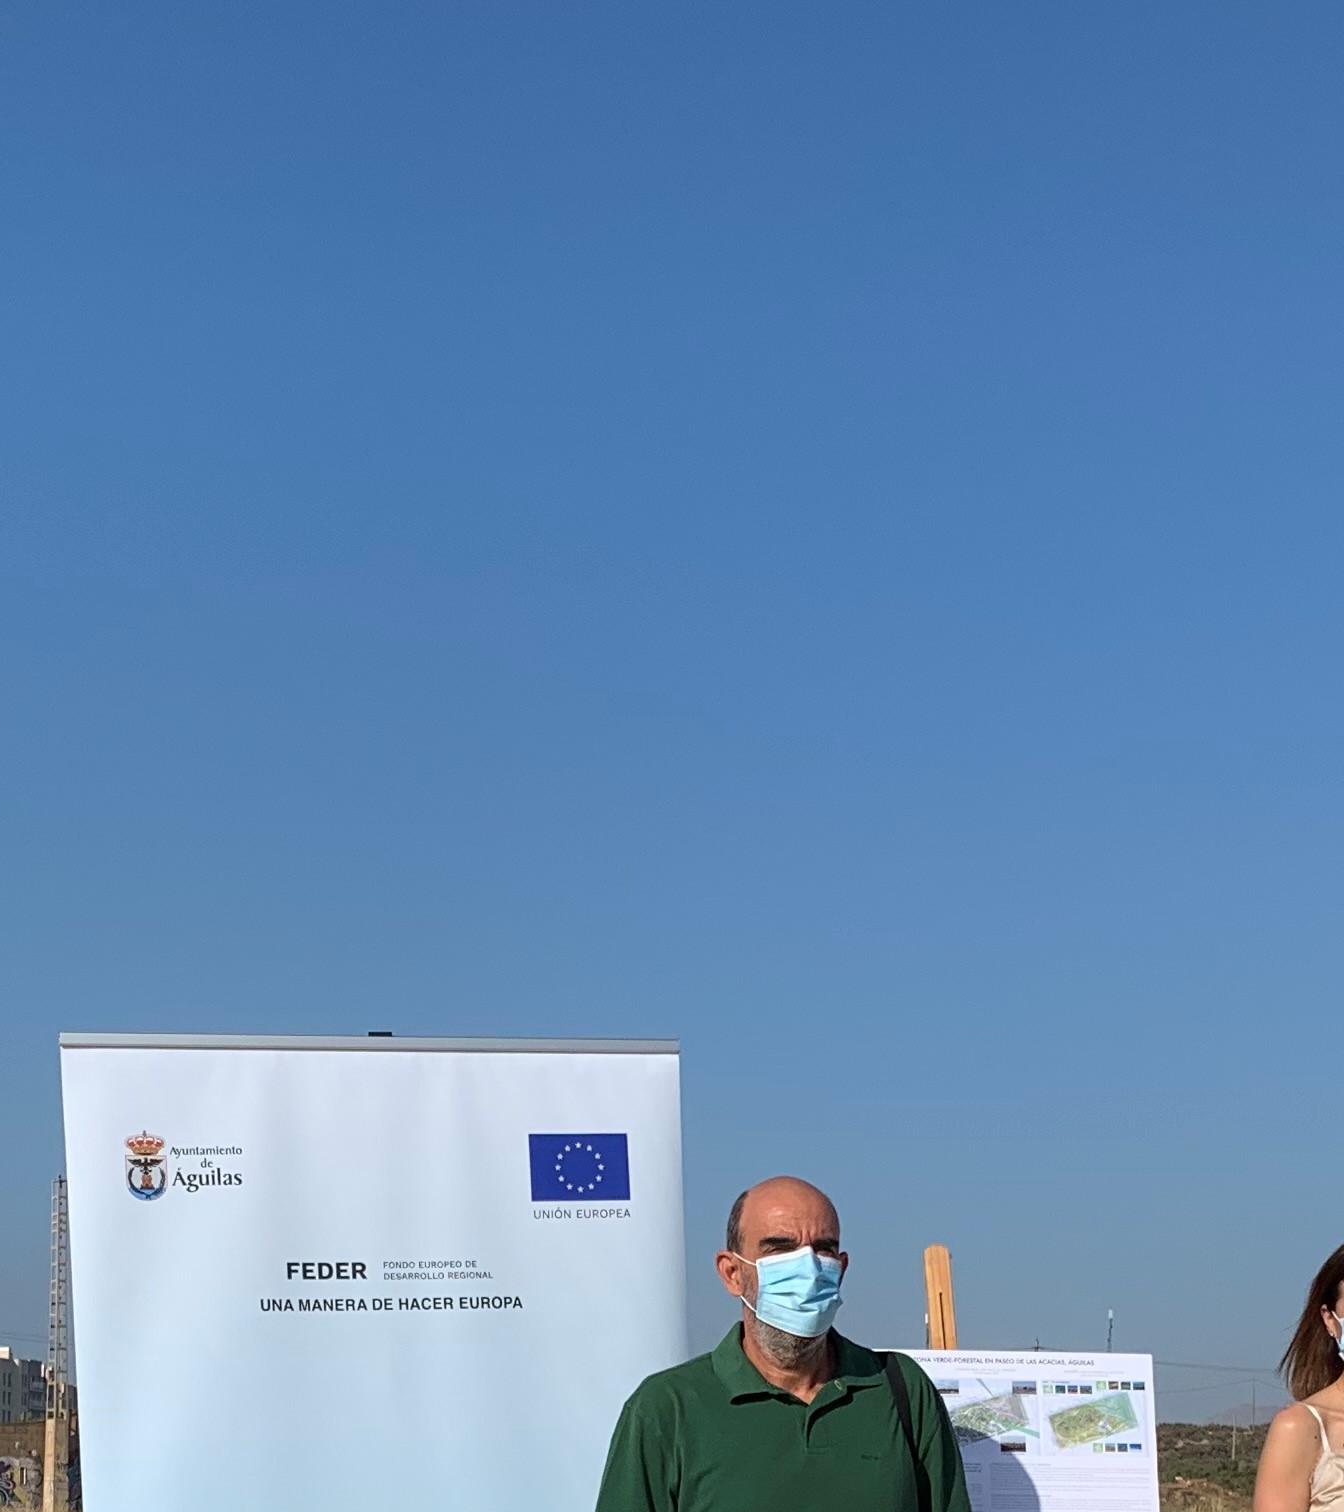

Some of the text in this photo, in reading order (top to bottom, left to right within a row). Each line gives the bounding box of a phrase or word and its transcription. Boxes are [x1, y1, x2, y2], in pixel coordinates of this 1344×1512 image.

[169, 1146, 243, 1159] Ayuntamiento
[200, 1158, 213, 1168] de
[172, 1167, 243, 1193] Águilas
[533, 1206, 631, 1220] UNIÓN EUROPEA
[286, 1262, 368, 1280] FEDER
[383, 1260, 477, 1269] FONDO EUROPEO DE
[383, 1271, 494, 1281] DESARROLLO REGIONAL
[260, 1296, 523, 1312] UNA MANERA DE HACER EUROPA
